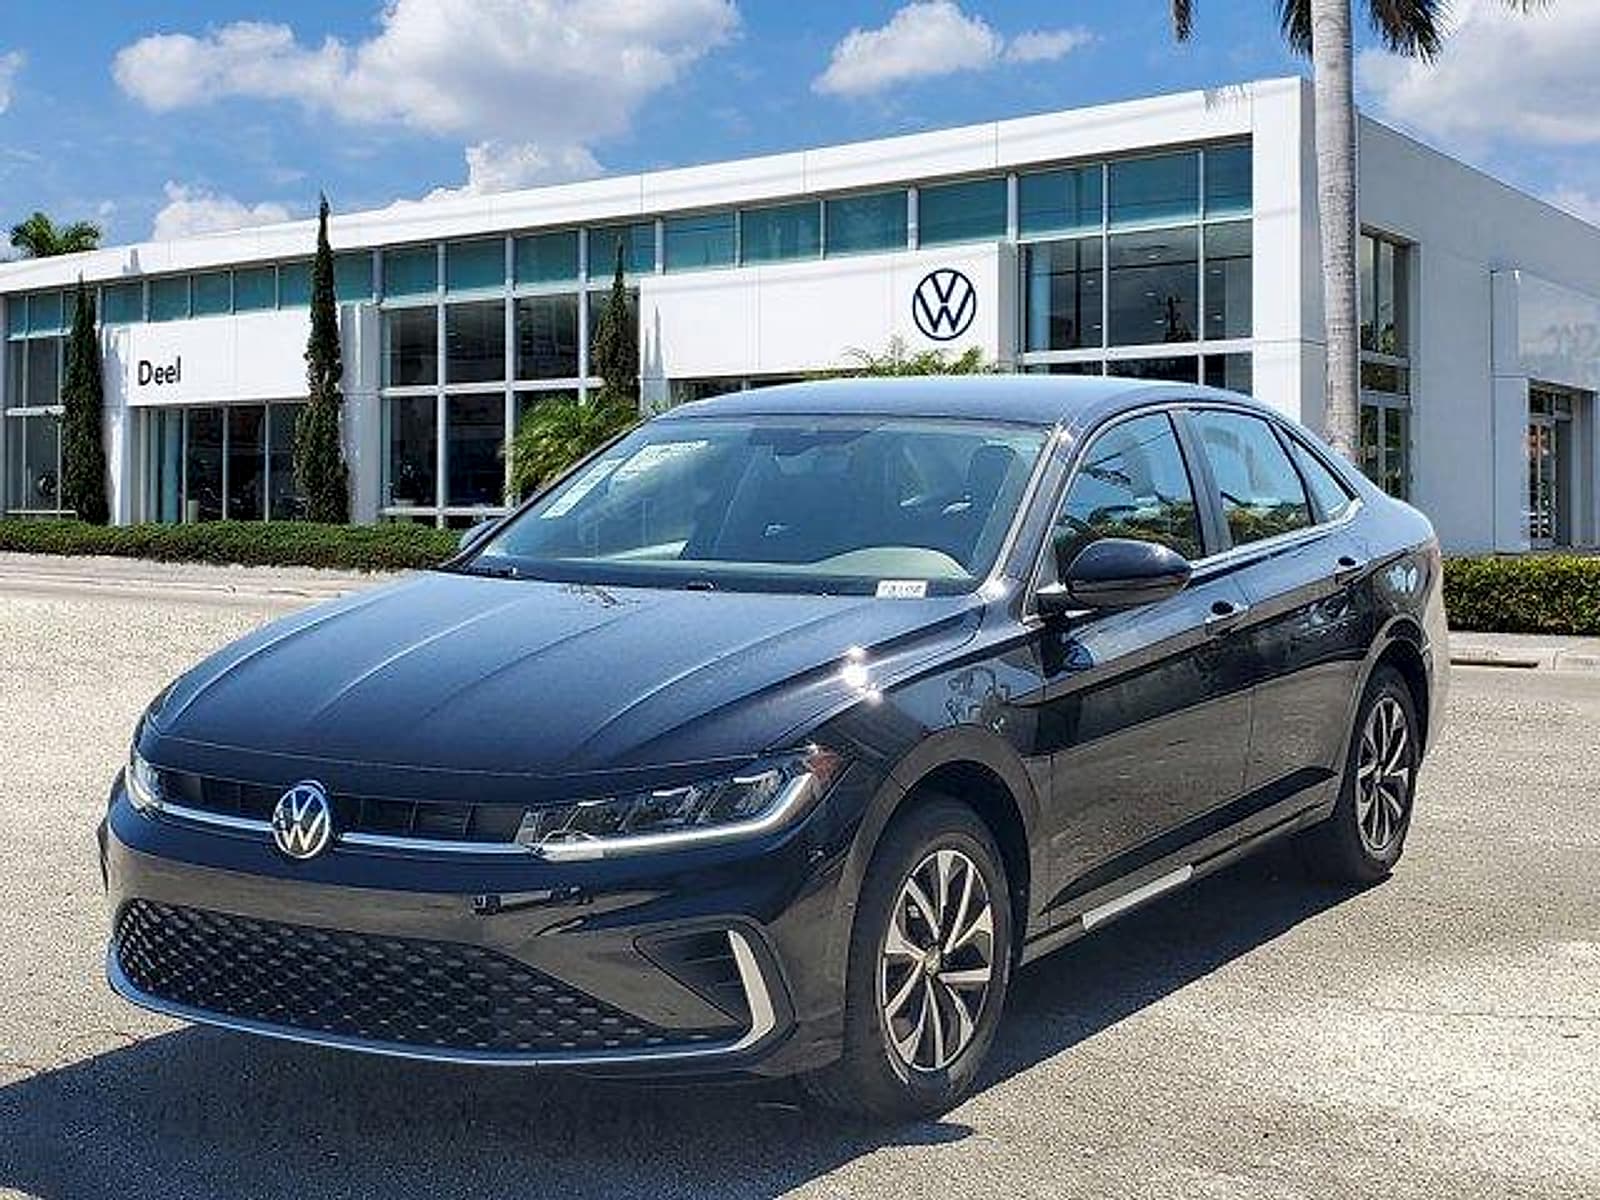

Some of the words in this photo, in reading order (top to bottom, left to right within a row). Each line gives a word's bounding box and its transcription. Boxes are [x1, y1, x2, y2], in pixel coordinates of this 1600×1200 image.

[914, 269, 975, 335] VW
[138, 355, 181, 386] Deel
[274, 786, 329, 853] VW
